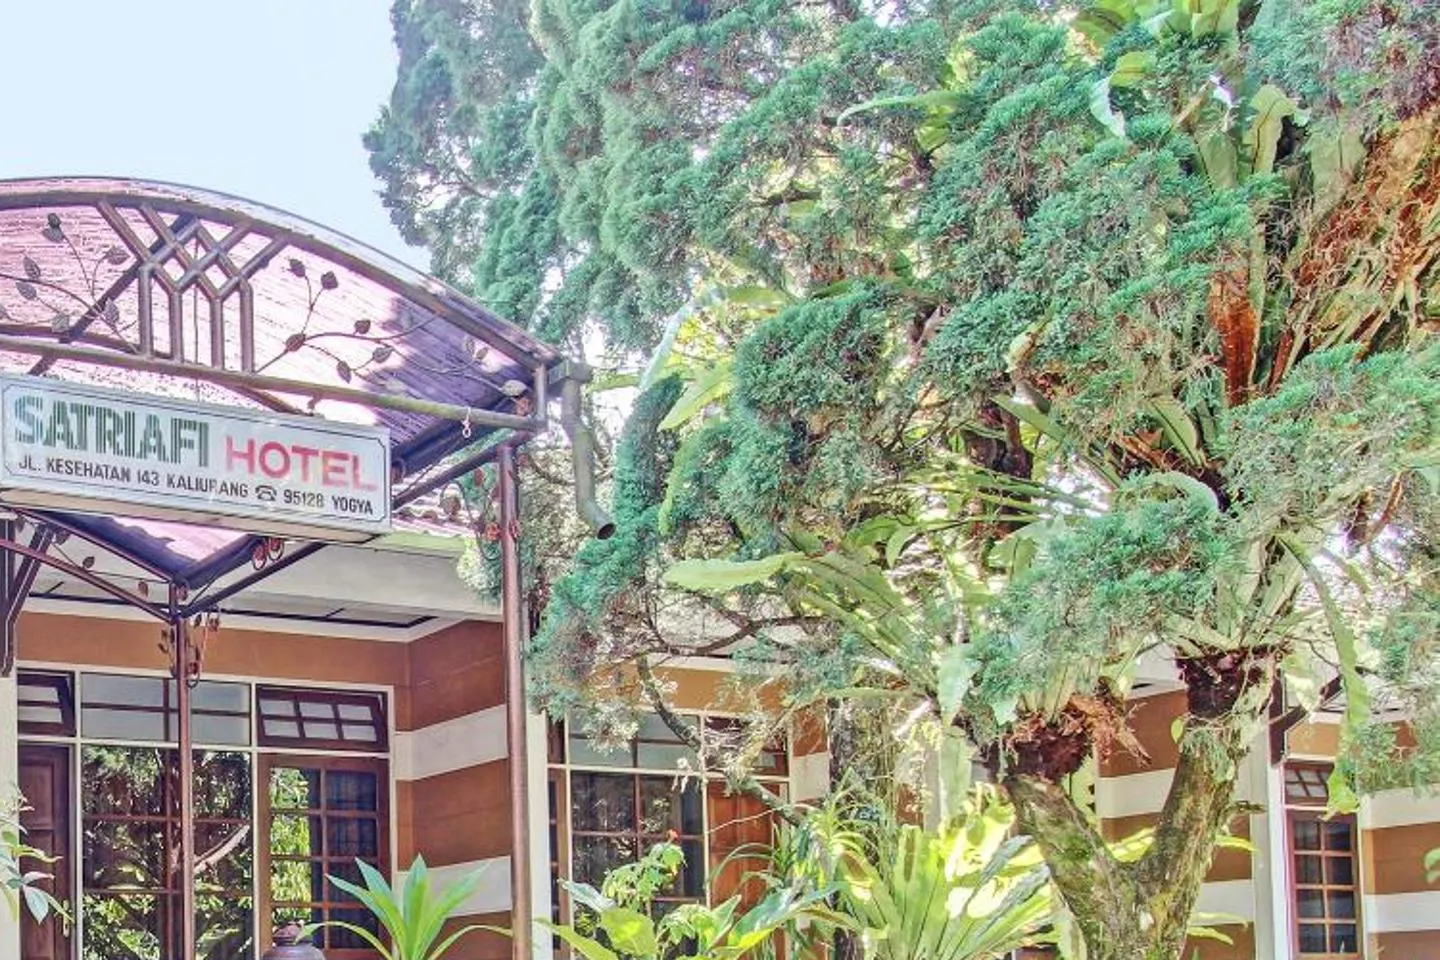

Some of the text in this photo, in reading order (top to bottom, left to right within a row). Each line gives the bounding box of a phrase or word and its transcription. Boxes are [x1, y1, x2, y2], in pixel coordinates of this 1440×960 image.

[14, 395, 210, 468] SATRIAFI
[225, 435, 379, 492] HOTEL
[18, 454, 374, 516] JL. KESEHATAN 143 KALIURANG 95128 YOGYA
